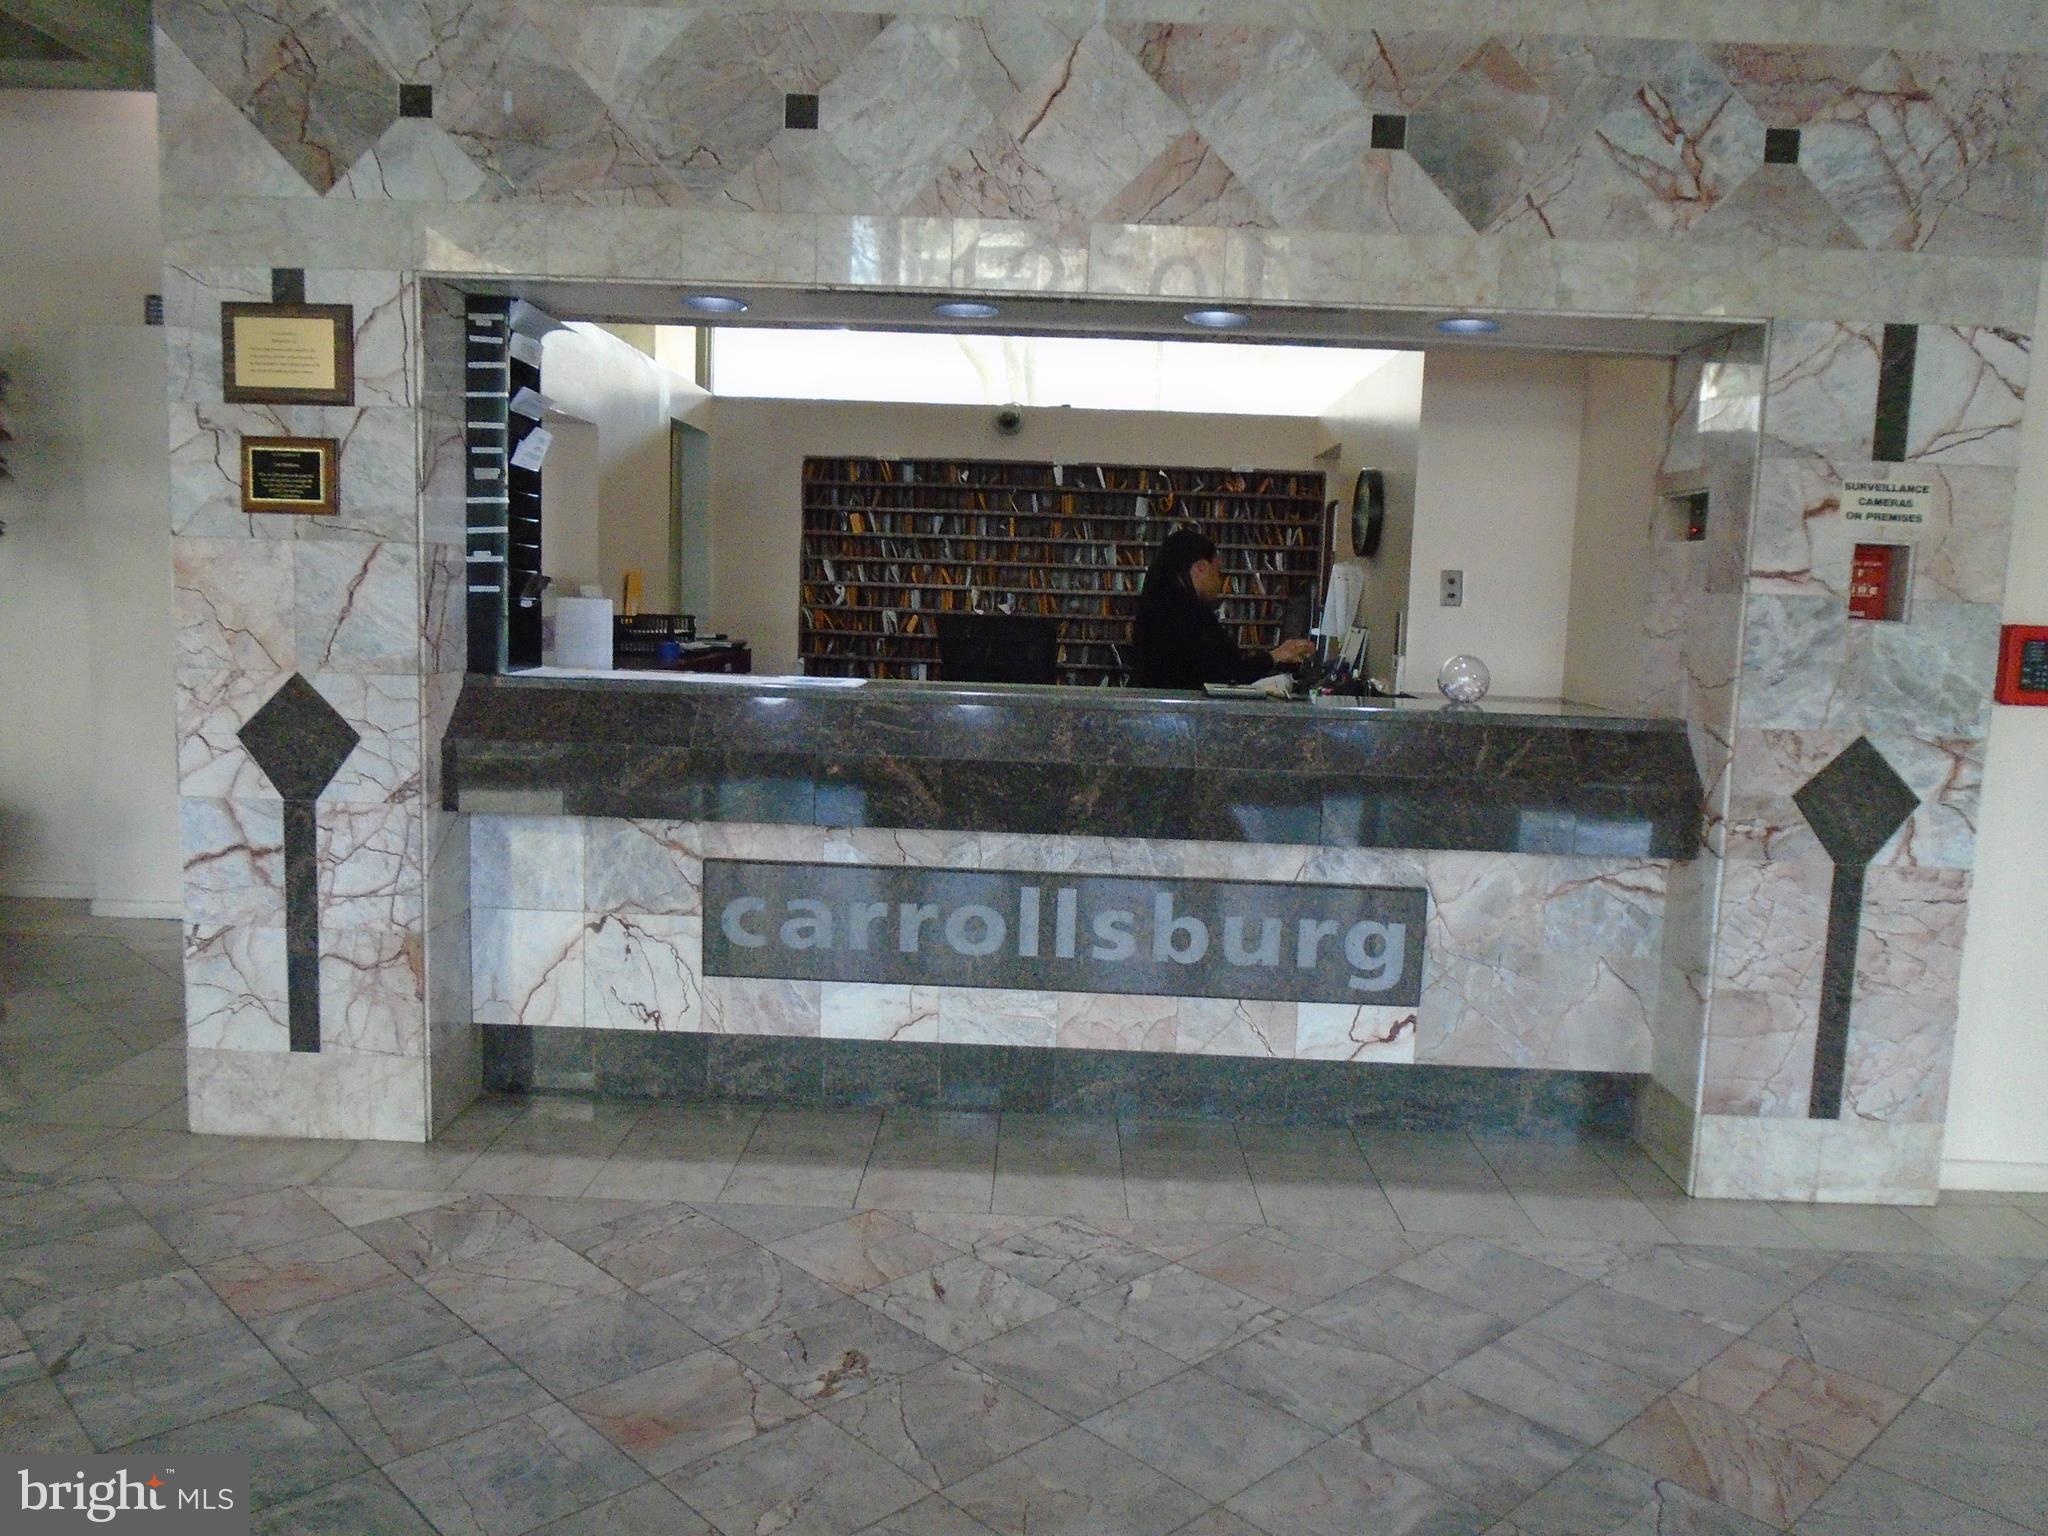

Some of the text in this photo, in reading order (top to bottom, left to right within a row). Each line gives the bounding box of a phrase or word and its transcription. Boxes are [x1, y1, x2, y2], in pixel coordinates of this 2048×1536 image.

[1844, 482, 1931, 494] SURVEILLANCE
[1858, 497, 1914, 508] CAMERAS
[1866, 512, 1923, 523] PREMISES
[720, 886, 1407, 992] carrollsburg
